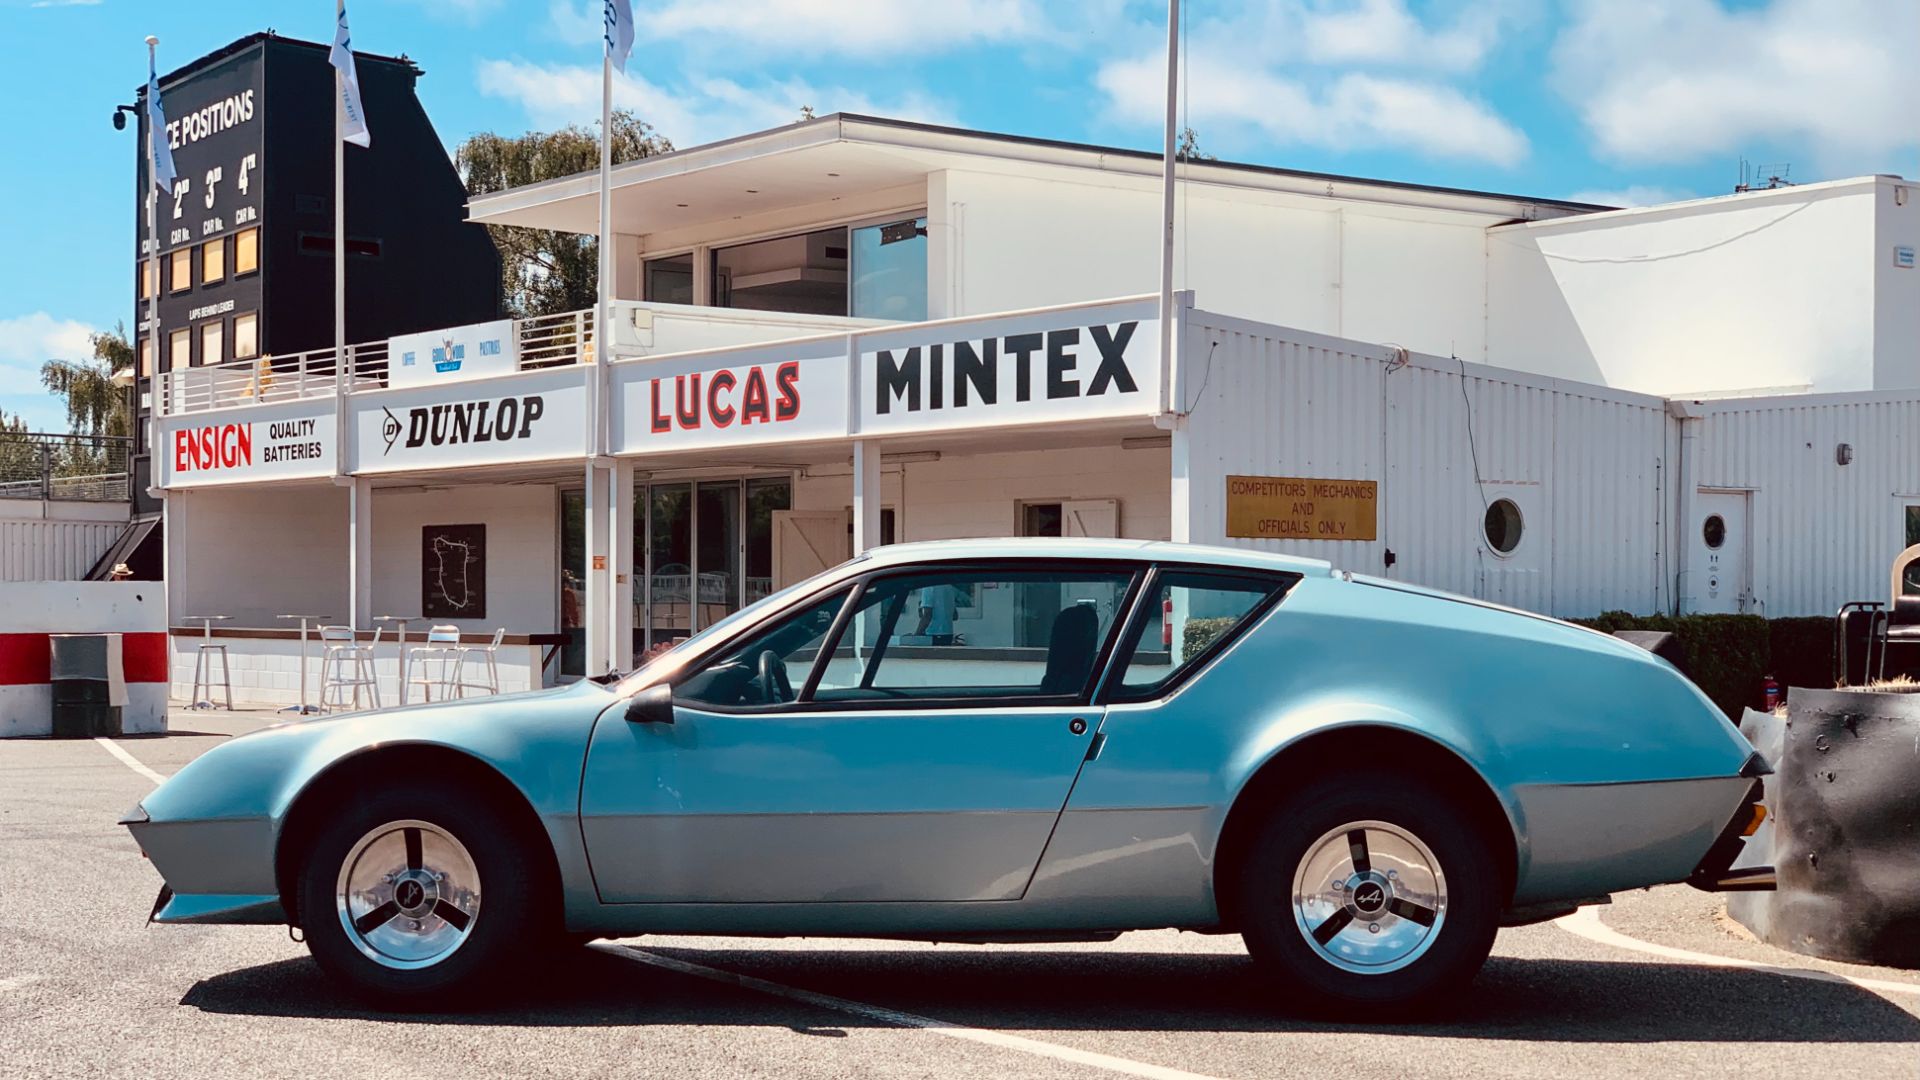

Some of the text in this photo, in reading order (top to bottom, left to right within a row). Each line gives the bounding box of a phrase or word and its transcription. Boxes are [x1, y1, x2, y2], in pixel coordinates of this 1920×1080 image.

[182, 89, 254, 147] POSITIONS
[203, 219, 214, 235] CAR
[235, 209, 247, 225] CAR
[171, 229, 181, 245] CAR
[189, 309, 201, 321] LAPS
[876, 320, 1139, 415] MINTEX
[650, 360, 800, 434] LUCAS
[269, 419, 315, 440] QUALITY
[405, 395, 544, 449] DUNLOP
[176, 421, 252, 472] ENSIGN
[264, 441, 321, 463] BATTERIES
[1231, 481, 1373, 500] COMPETITORS MECHANICS
[1291, 502, 1314, 516] AND
[1258, 519, 1346, 535] OFFICIALS ONLY
